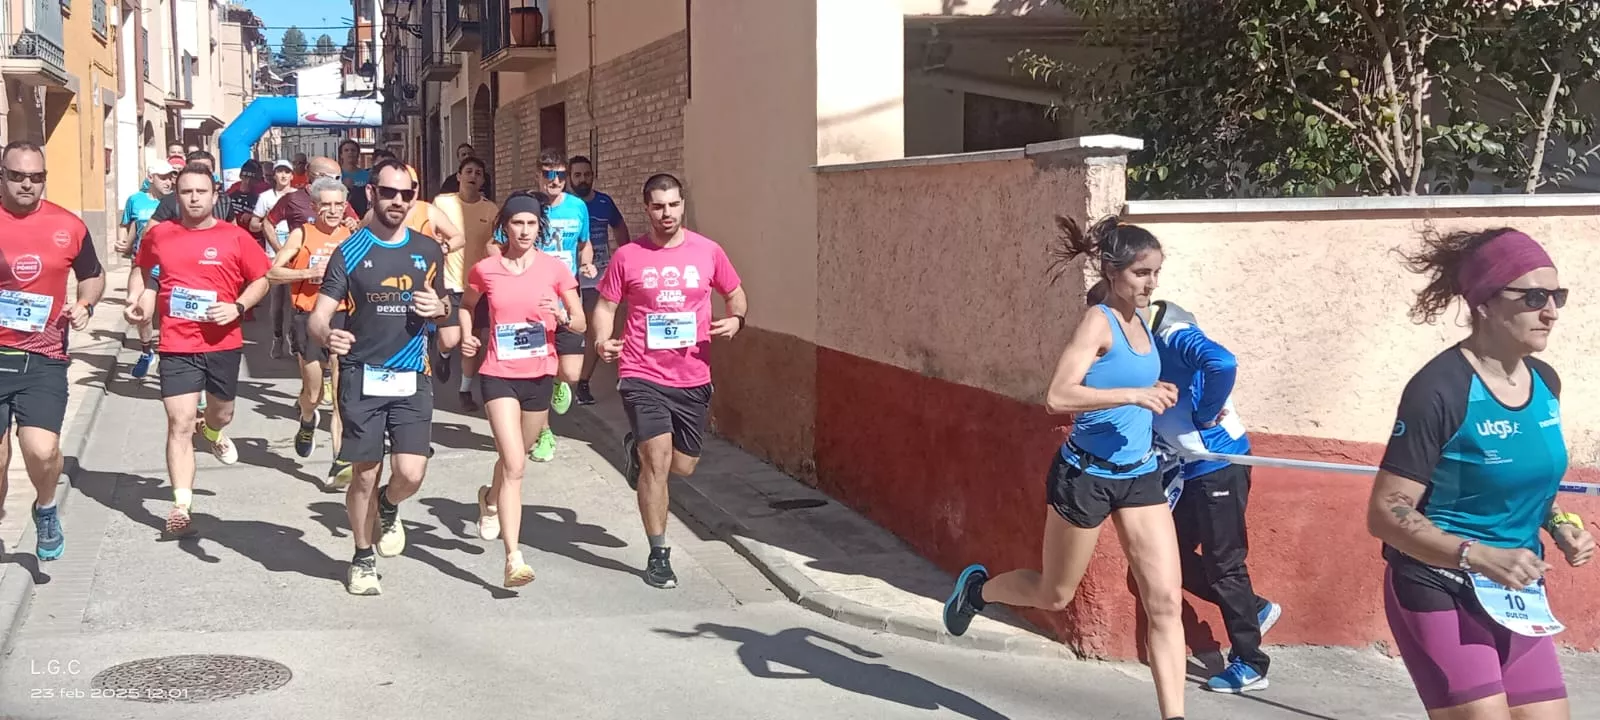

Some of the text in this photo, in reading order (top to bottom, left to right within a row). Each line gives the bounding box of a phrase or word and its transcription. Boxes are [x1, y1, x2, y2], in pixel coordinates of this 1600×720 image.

[185, 301, 198, 310] 80
[15, 307, 31, 317] 13
[664, 327, 678, 336] 67
[1475, 419, 1514, 439] utgs
[1505, 593, 1526, 611] 10
